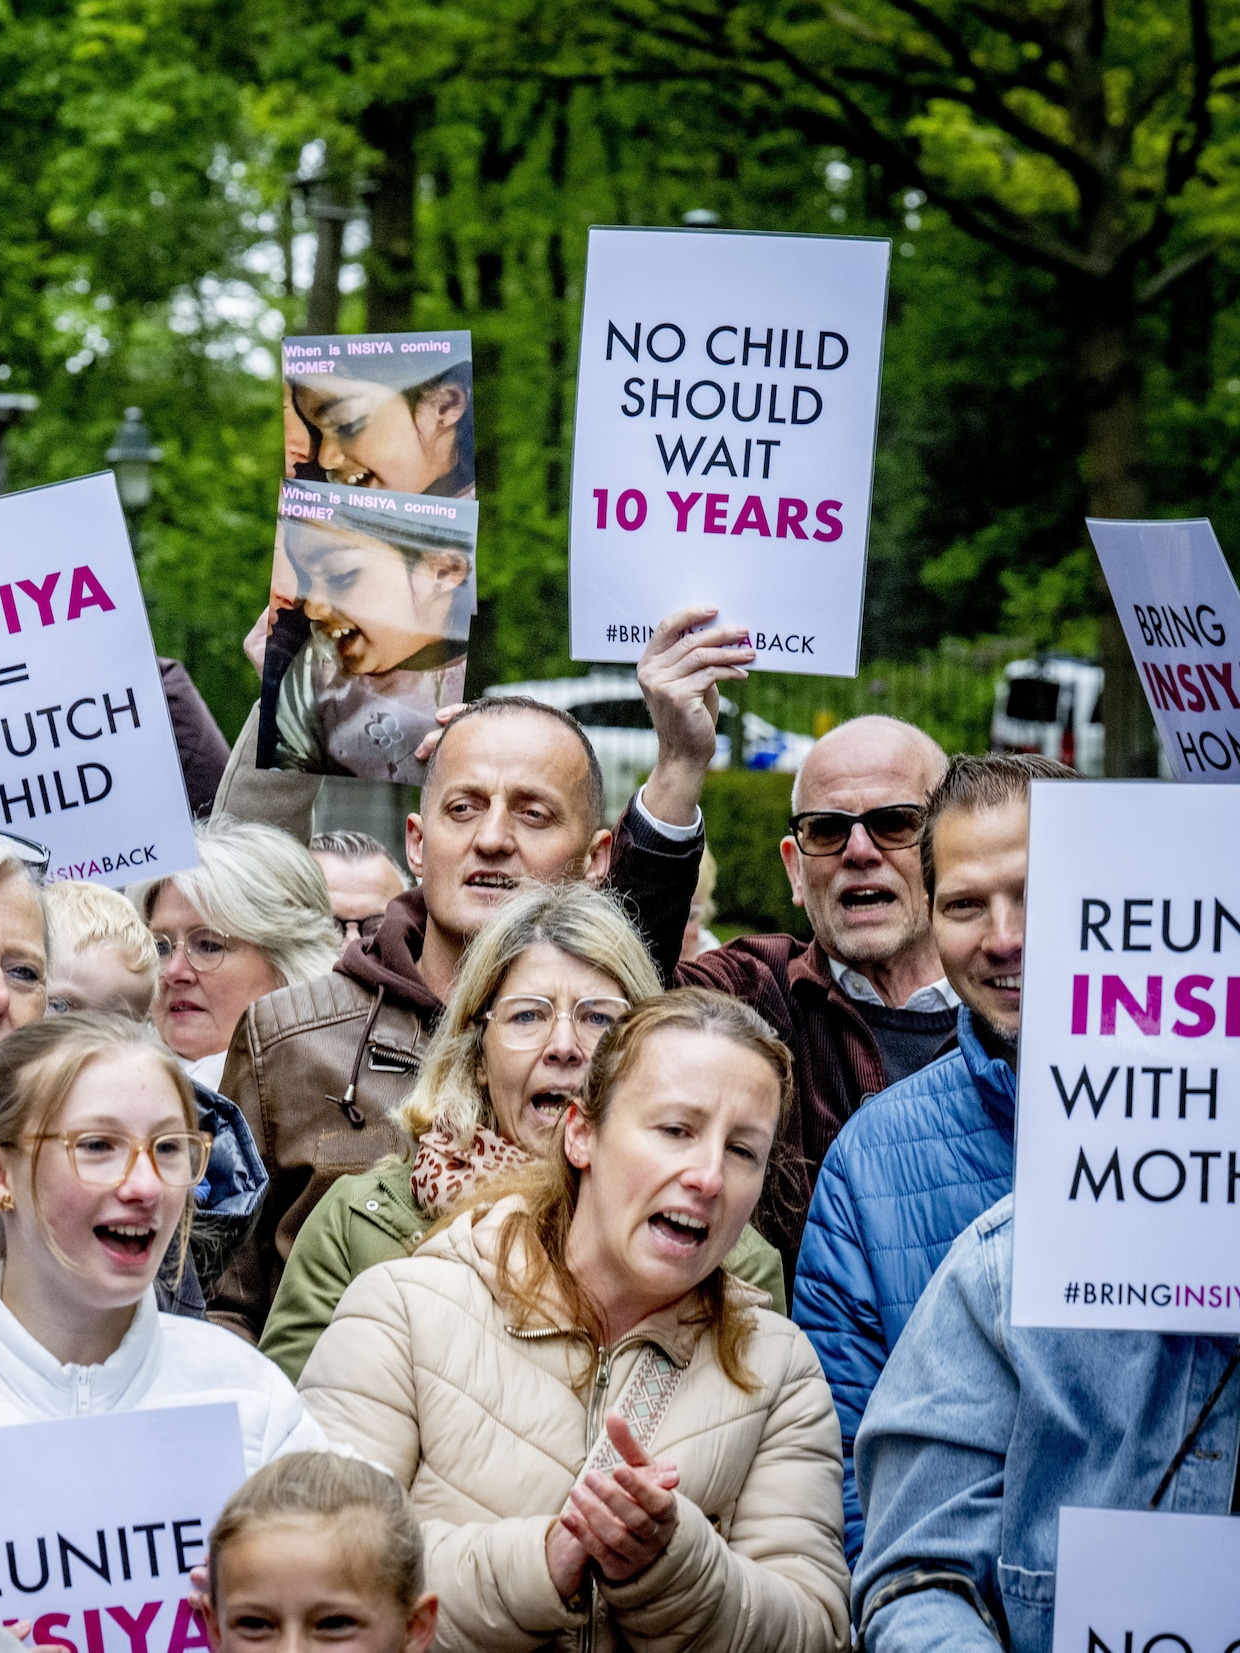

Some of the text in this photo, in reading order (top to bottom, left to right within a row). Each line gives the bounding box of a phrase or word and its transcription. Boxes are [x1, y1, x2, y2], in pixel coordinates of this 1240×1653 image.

[283, 339, 451, 358] When is INSIYA coming
[284, 360, 336, 375] HOME?
[605, 319, 849, 371] NO CHILD
[620, 376, 823, 425] SHOULD
[655, 433, 781, 480] WAIT
[280, 503, 335, 521] HOME?
[281, 487, 457, 520] When is INSIYA coming
[592, 488, 844, 543] 10 YEARS
[1133, 603, 1226, 648] BRING
[1142, 661, 1240, 713] INSIY
[1050, 1065, 1219, 1120] WITH
